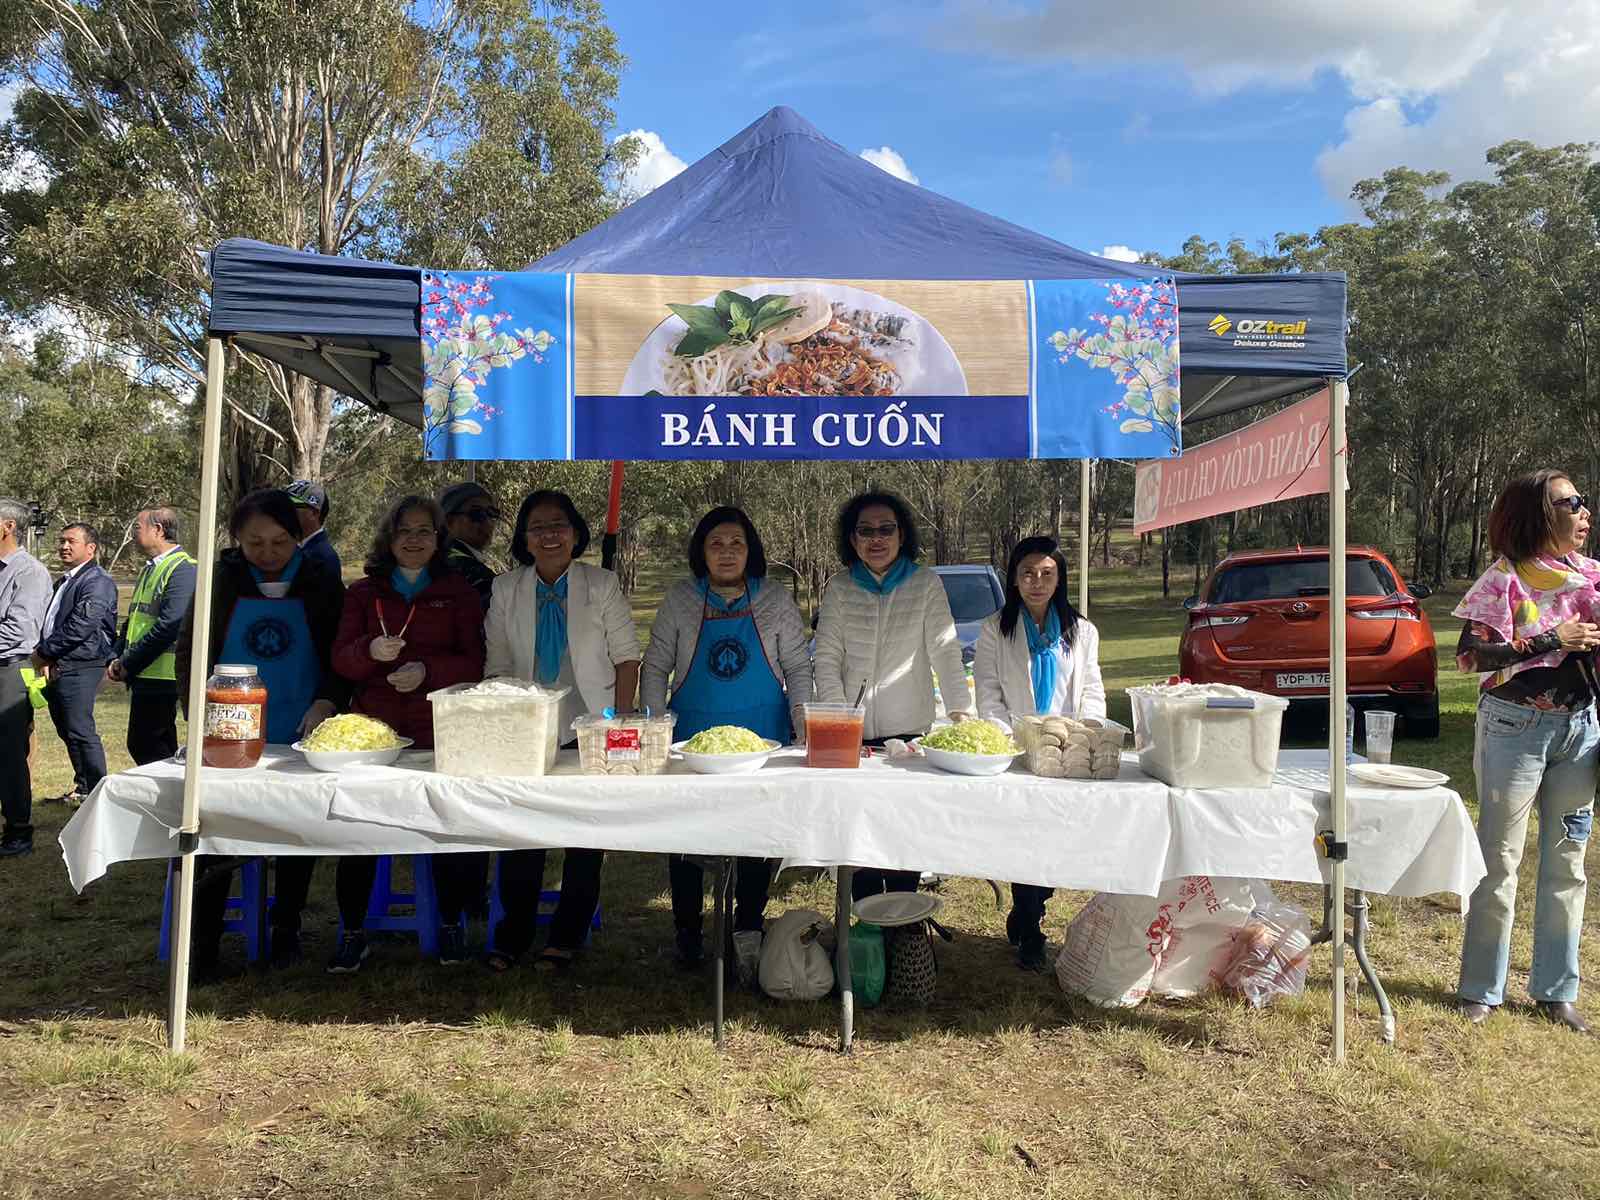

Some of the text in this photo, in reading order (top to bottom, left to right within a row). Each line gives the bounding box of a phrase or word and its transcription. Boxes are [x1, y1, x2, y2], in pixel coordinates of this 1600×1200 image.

[1236, 319, 1306, 334] OZtrail
[660, 400, 945, 447] BÁNH CUỐN
